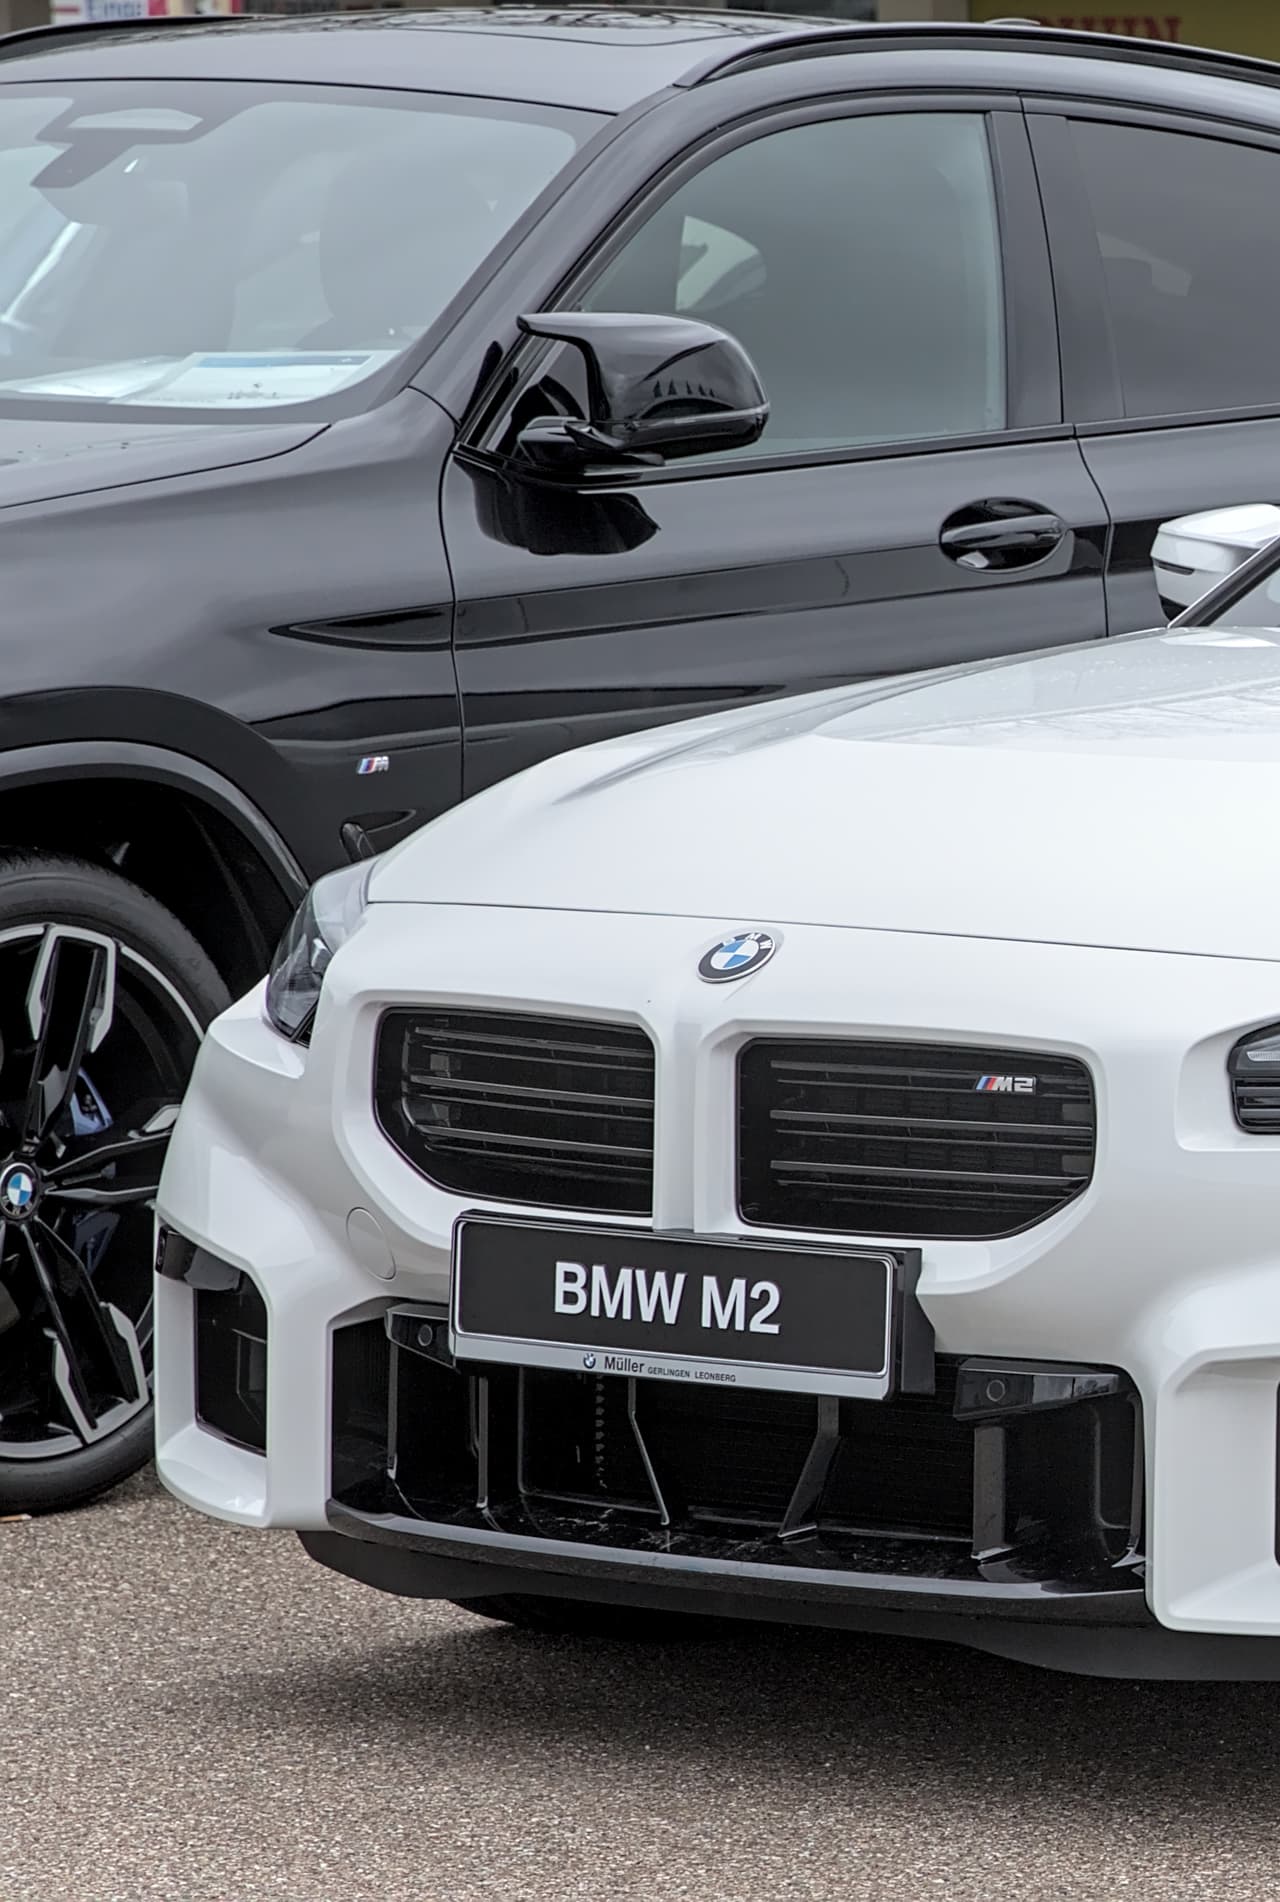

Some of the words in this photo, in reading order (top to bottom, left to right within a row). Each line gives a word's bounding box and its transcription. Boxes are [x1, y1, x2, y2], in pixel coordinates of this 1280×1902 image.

[553, 1260, 688, 1325] BMW
[702, 1275, 781, 1335] M2
[604, 1355, 645, 1374] Müller
[647, 1366, 690, 1378] GERLINGEN
[694, 1371, 737, 1383] LEONBERG
